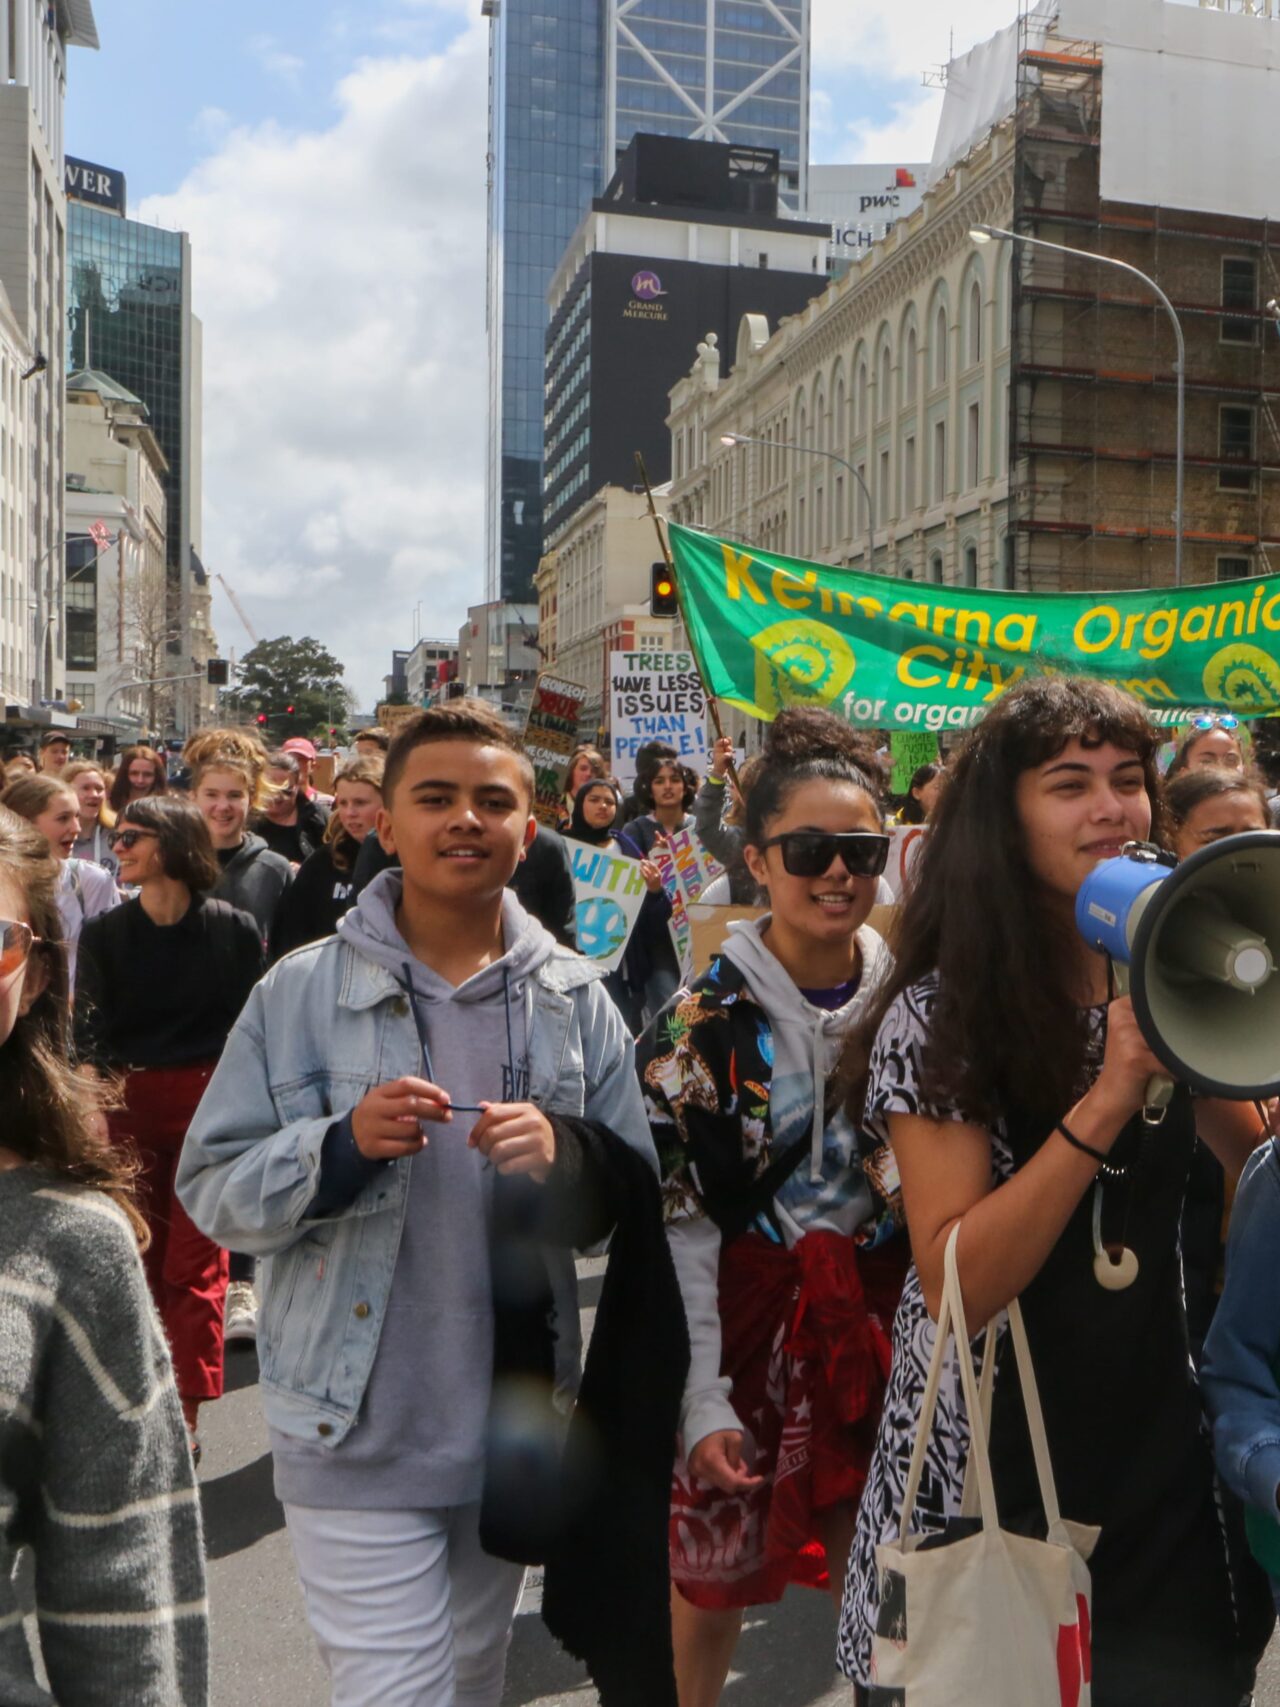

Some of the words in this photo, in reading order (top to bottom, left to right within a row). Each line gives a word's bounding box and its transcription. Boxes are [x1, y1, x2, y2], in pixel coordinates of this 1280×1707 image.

[64, 164, 112, 197] WER
[859, 194, 900, 213] pwc
[829, 228, 873, 248] ICH
[623, 309, 669, 321] MERCURE
[628, 300, 663, 311] GRAND
[623, 653, 691, 672] TREES
[612, 675, 651, 693] HAVE
[658, 672, 704, 692] LESS
[617, 692, 703, 718] ISSUES
[843, 691, 886, 721] for
[630, 714, 686, 735] THAN
[571, 848, 646, 896] WITH
